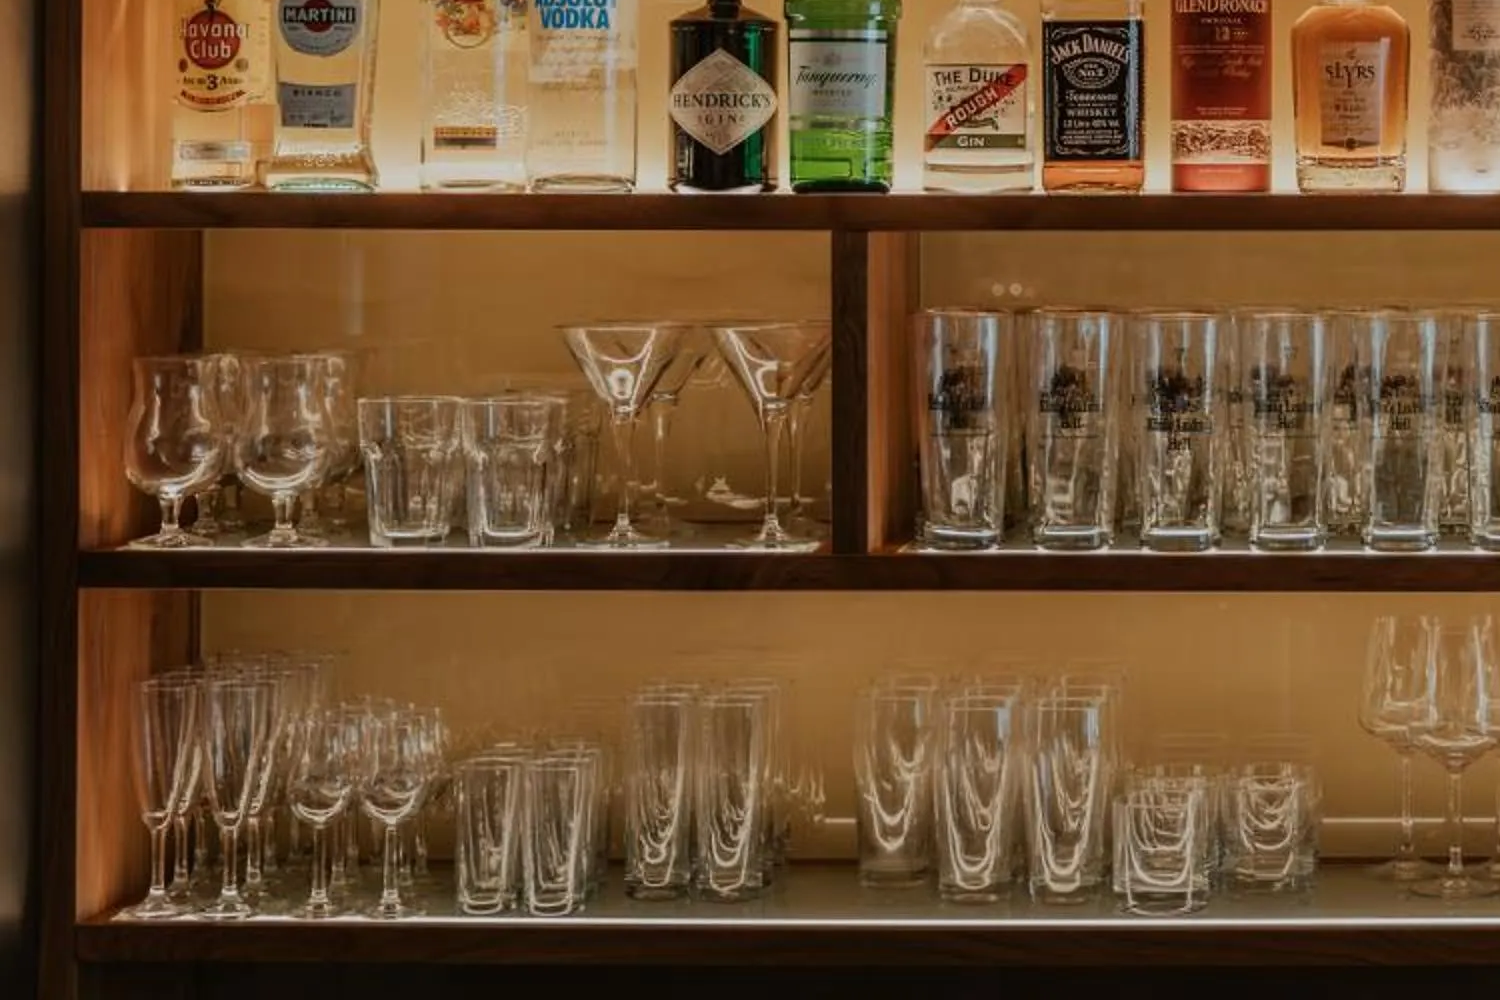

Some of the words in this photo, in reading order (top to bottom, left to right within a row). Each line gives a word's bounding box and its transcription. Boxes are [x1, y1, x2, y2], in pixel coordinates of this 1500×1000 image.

[284, 7, 355, 22] MARTINI
[540, 7, 611, 30] VODKA
[190, 39, 232, 58] Club
[1050, 39, 1081, 64] JACK
[206, 73, 218, 90] 3
[933, 71, 962, 86] THE
[969, 67, 1014, 86] DUKE
[1325, 61, 1375, 88] SLYRS
[673, 92, 772, 109] HENDRICK'S
[944, 87, 999, 129] ROUGH
[704, 113, 737, 125] GIN
[956, 136, 985, 147] GIN
